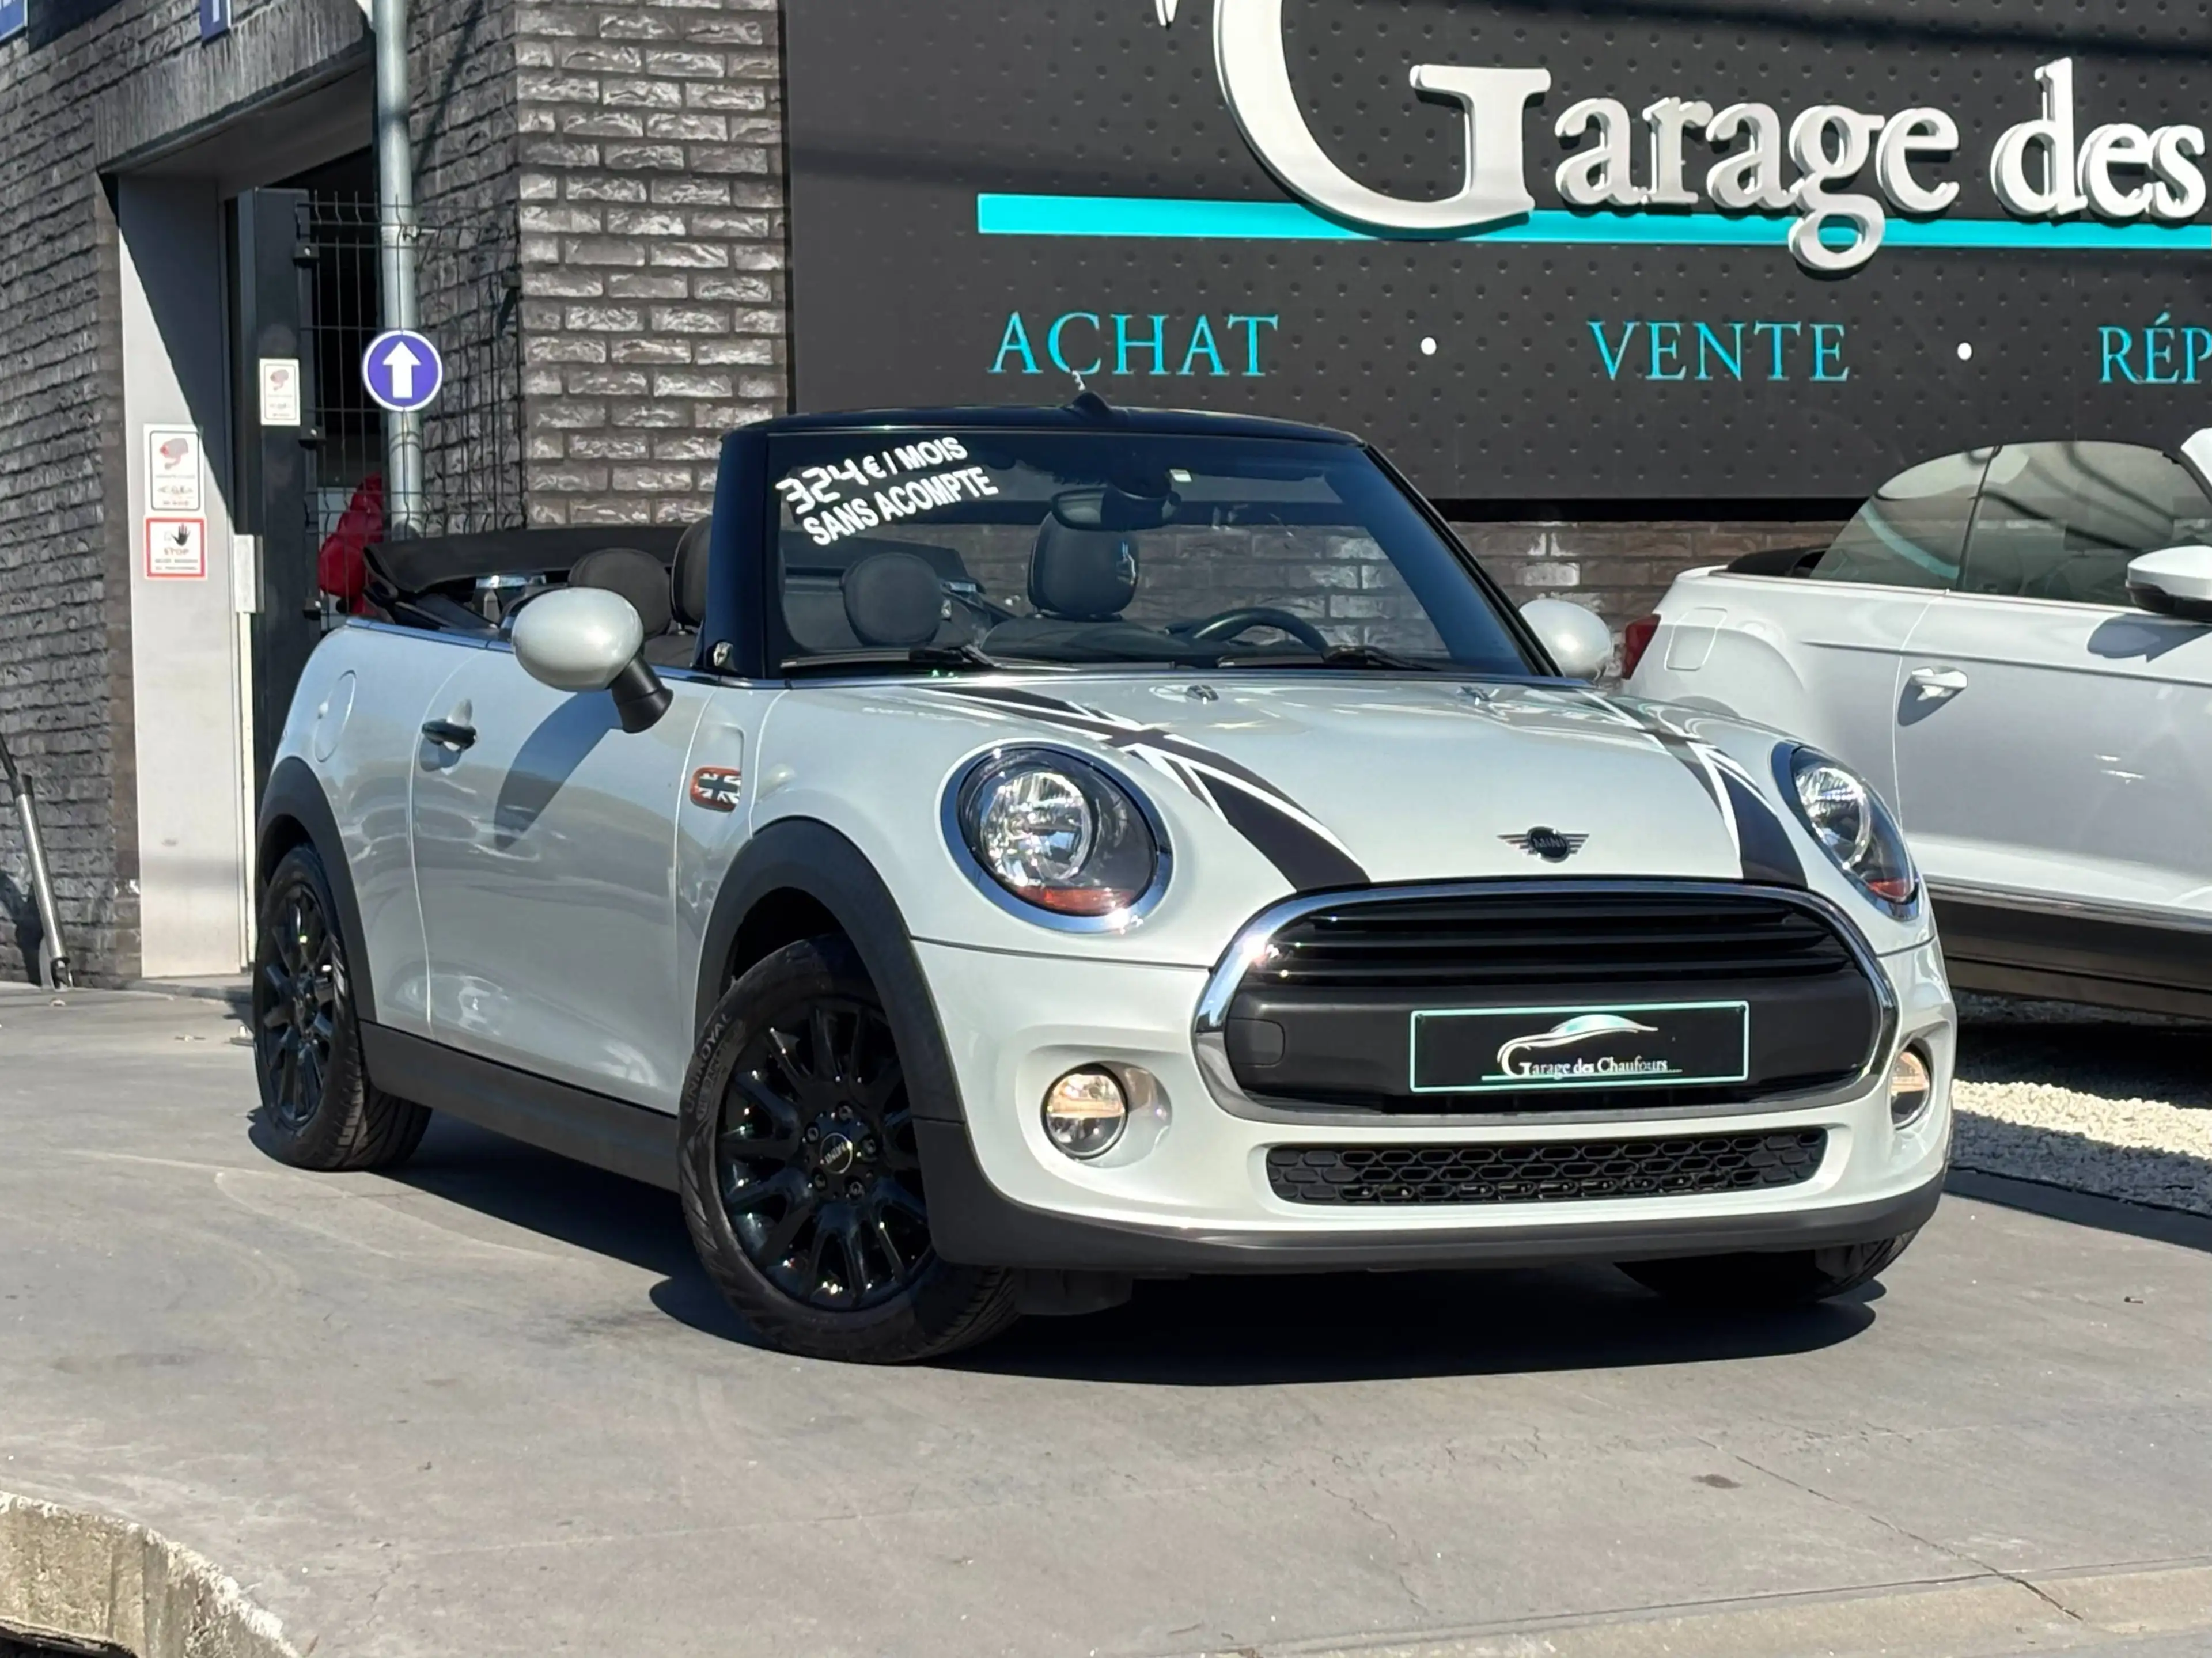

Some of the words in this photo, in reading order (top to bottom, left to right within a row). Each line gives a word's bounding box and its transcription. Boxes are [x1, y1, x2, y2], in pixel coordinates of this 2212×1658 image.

[1213, 0, 1960, 270] Garage
[1990, 56, 2207, 219] des
[987, 310, 1279, 377] ACHAT
[1586, 320, 1850, 382] VENTE
[2097, 311, 2212, 384] RÉP
[894, 437, 968, 471] MOIS
[803, 498, 879, 545] SANS
[874, 466, 999, 521] ACOMPTE
[1501, 1045, 1571, 1080] Garage
[1573, 1057, 1594, 1074] des
